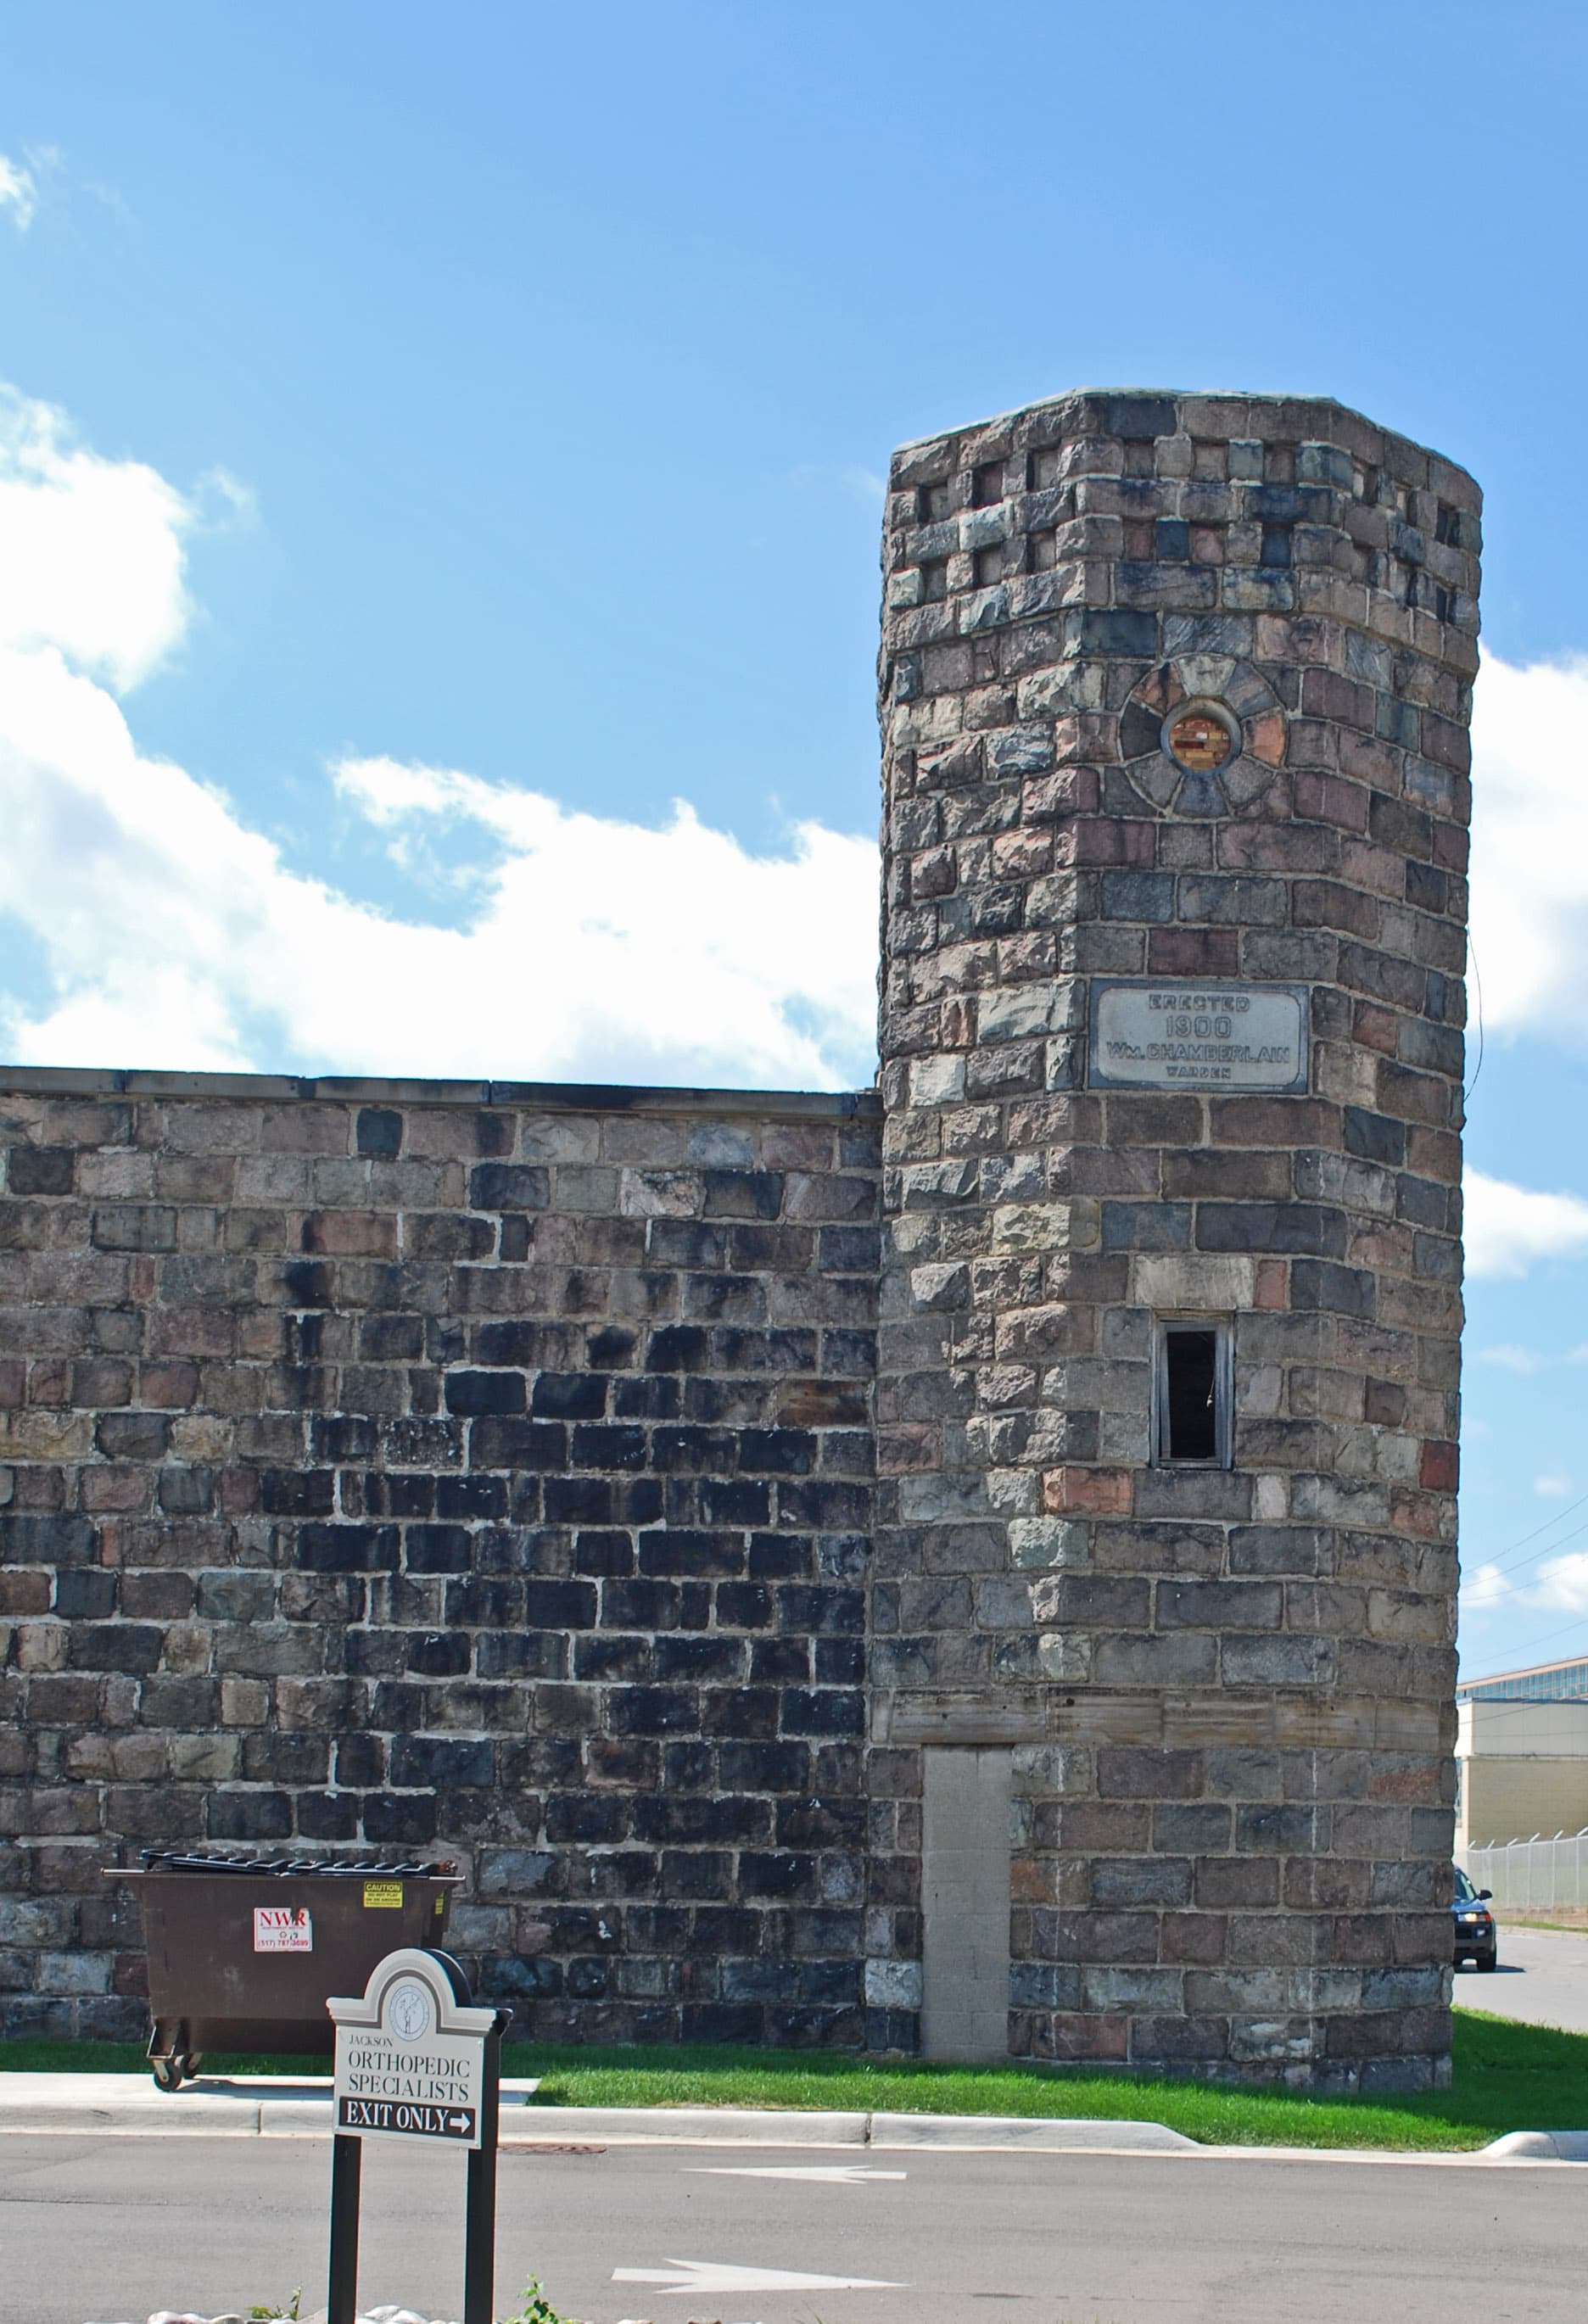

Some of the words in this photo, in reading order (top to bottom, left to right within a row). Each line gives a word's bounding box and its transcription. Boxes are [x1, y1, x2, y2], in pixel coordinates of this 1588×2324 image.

[1149, 994, 1250, 1013] ERECTED
[1166, 1016, 1232, 1039] 1900
[1147, 1042, 1290, 1064] CHAMBERLAIN
[1166, 1065, 1231, 1080] WARDEN
[260, 1911, 306, 1926] NWR
[349, 2035, 394, 2047] JACKSON
[349, 2051, 470, 2078] ORTHOPEDIC
[349, 2074, 469, 2102] SPECIALISTS
[347, 2100, 393, 2127] EXIT
[396, 2105, 449, 2132] ONLY
